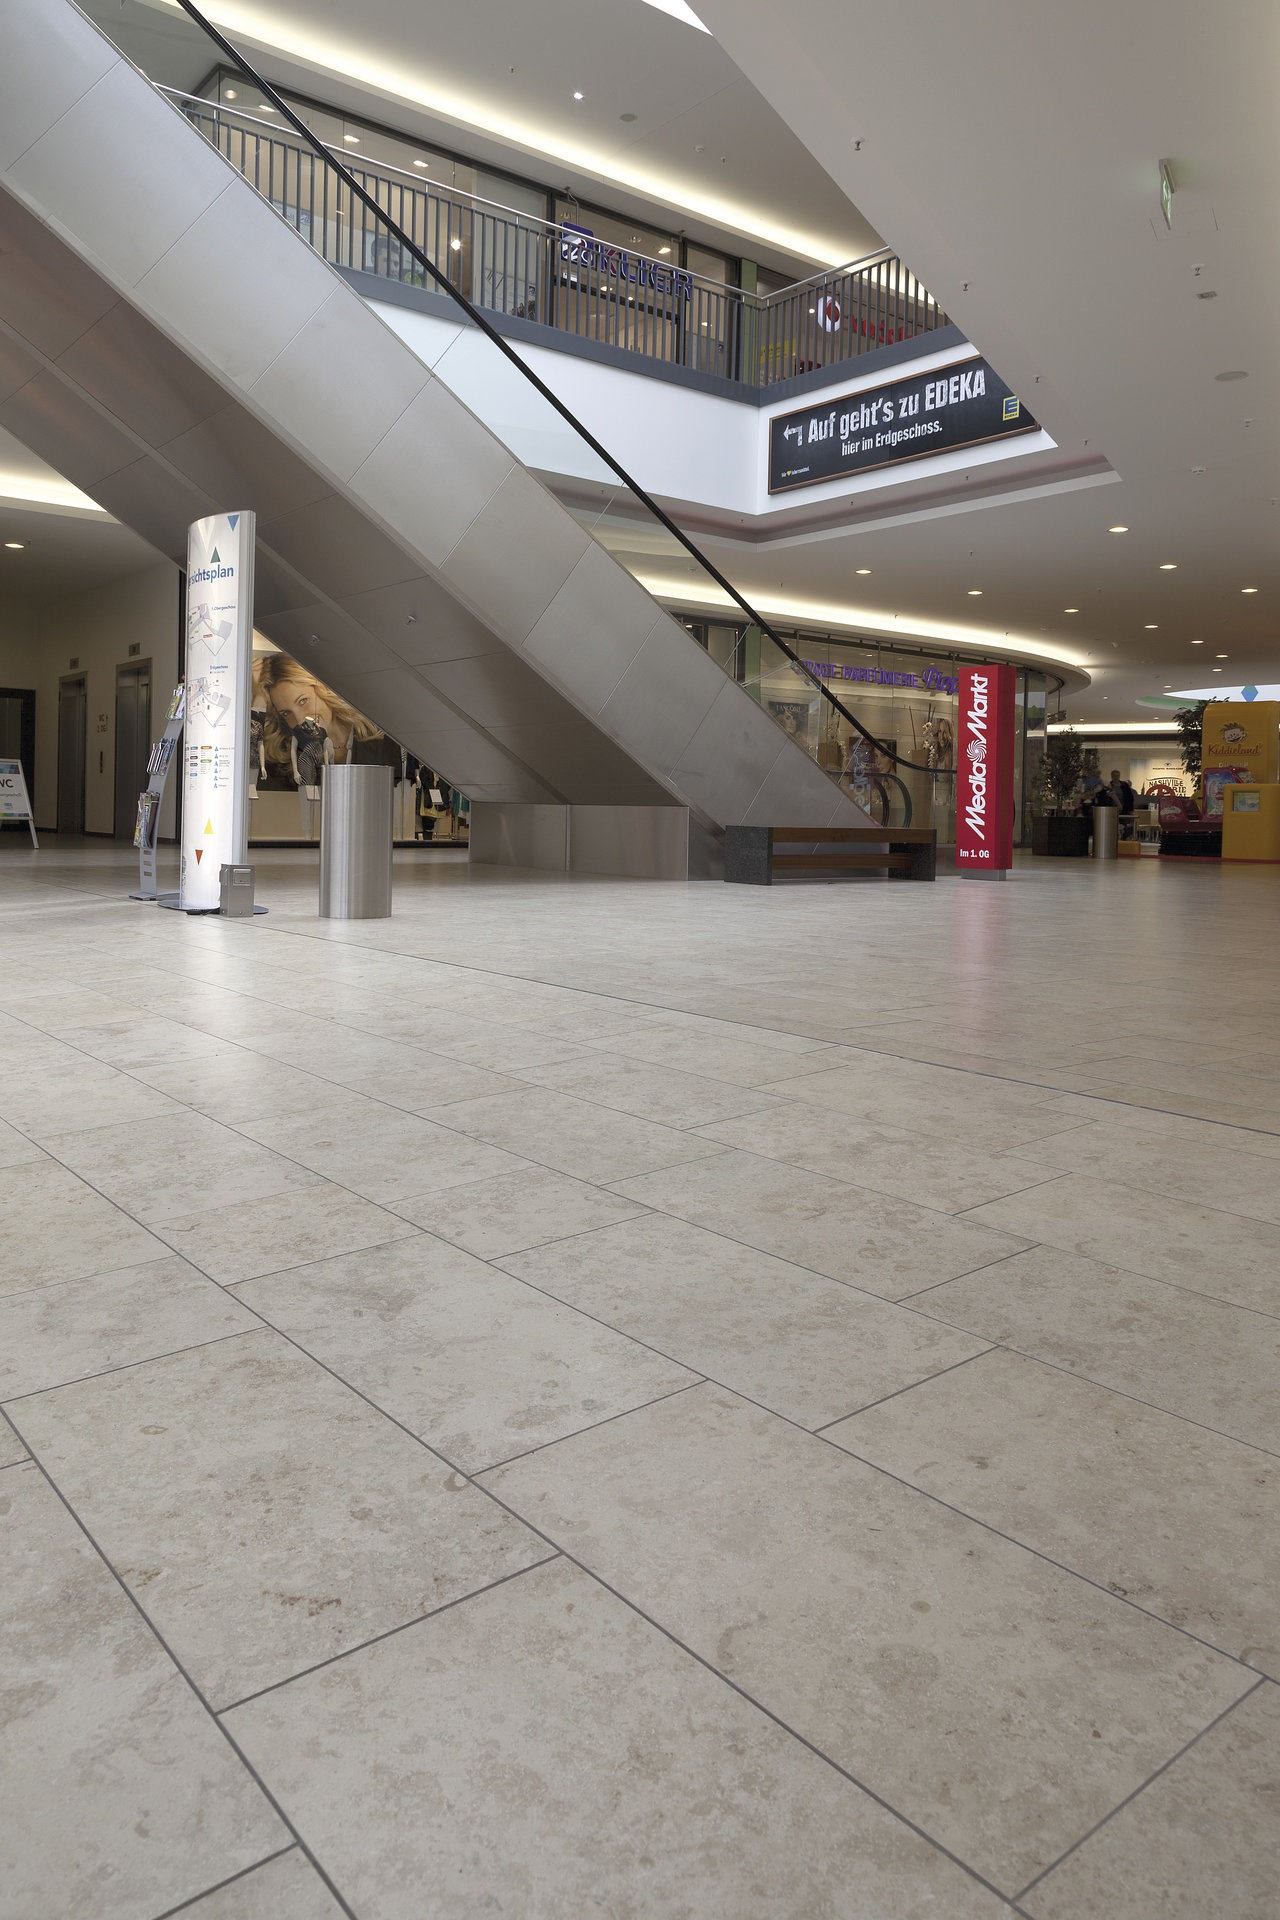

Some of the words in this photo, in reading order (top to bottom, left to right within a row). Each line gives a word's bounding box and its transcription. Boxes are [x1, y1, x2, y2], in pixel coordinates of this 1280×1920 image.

[598, 244, 693, 300] KLIER
[808, 411, 837, 444] Auf
[840, 397, 894, 441] geht's
[899, 396, 919, 419] zu
[925, 369, 986, 412] EDEKA
[841, 439, 861, 456] hier
[862, 437, 873, 450] im
[876, 419, 943, 448] Erdgeschoss.
[922, 667, 959, 696] Piep
[967, 673, 988, 744] Markt
[1208, 743, 1259, 756] Kiddieland
[965, 760, 987, 840] Media
[959, 848, 969, 858] Im
[970, 848, 978, 858] 1.
[979, 848, 990, 859] OG
